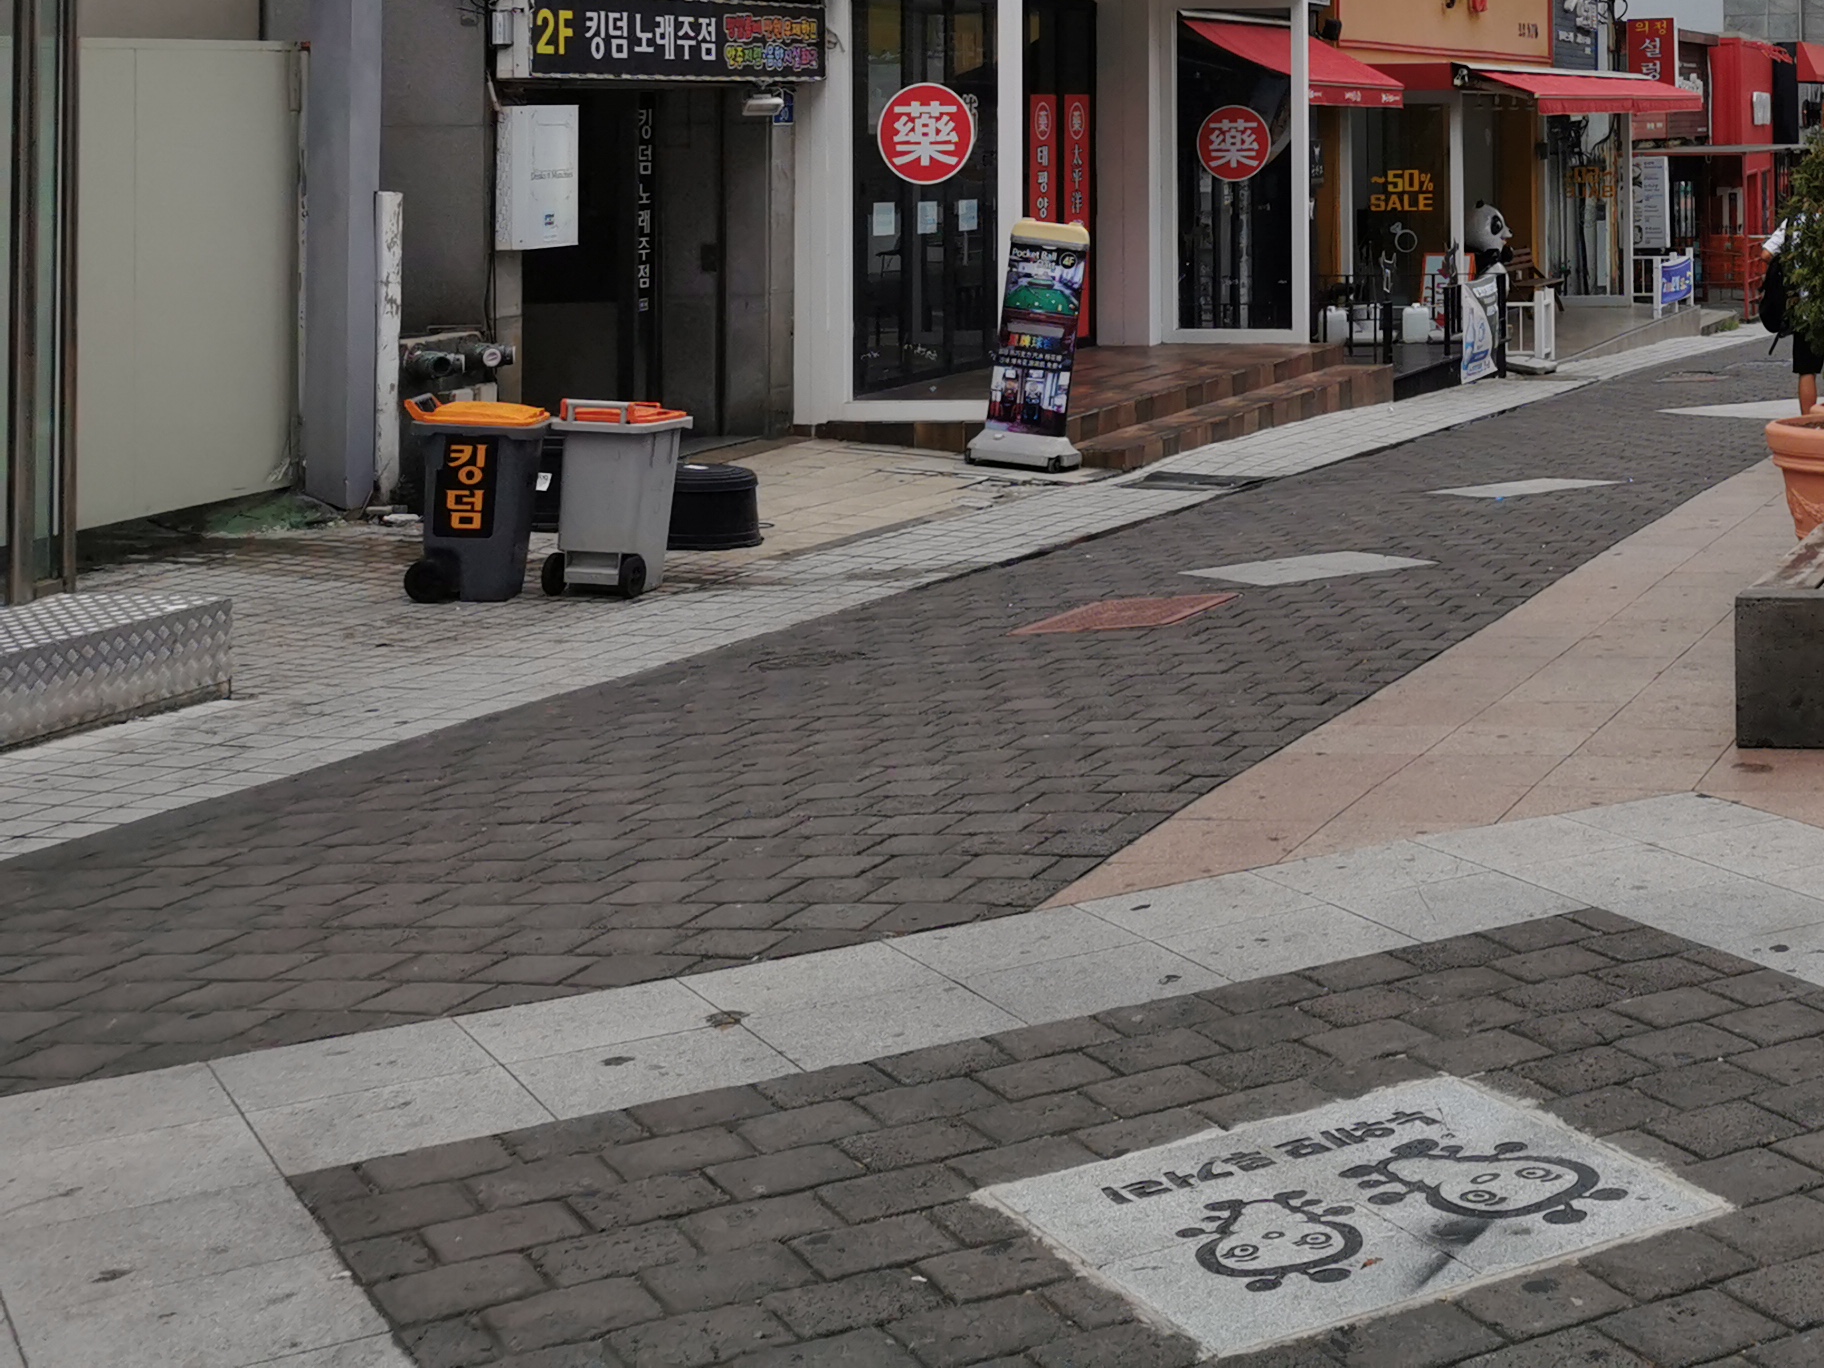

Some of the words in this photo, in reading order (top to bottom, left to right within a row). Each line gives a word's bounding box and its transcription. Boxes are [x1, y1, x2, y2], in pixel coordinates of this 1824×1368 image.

[535, 8, 574, 55] 2F
[584, 11, 629, 60] 킹덤
[634, 13, 717, 62] 노래주점
[892, 100, 959, 167] 藥
[1208, 118, 1260, 168] 藥
[1036, 145, 1049, 219] 태평양
[1071, 144, 1083, 215] 太平洋
[1370, 194, 1434, 212] SALE
[444, 443, 489, 531] 킹덤
